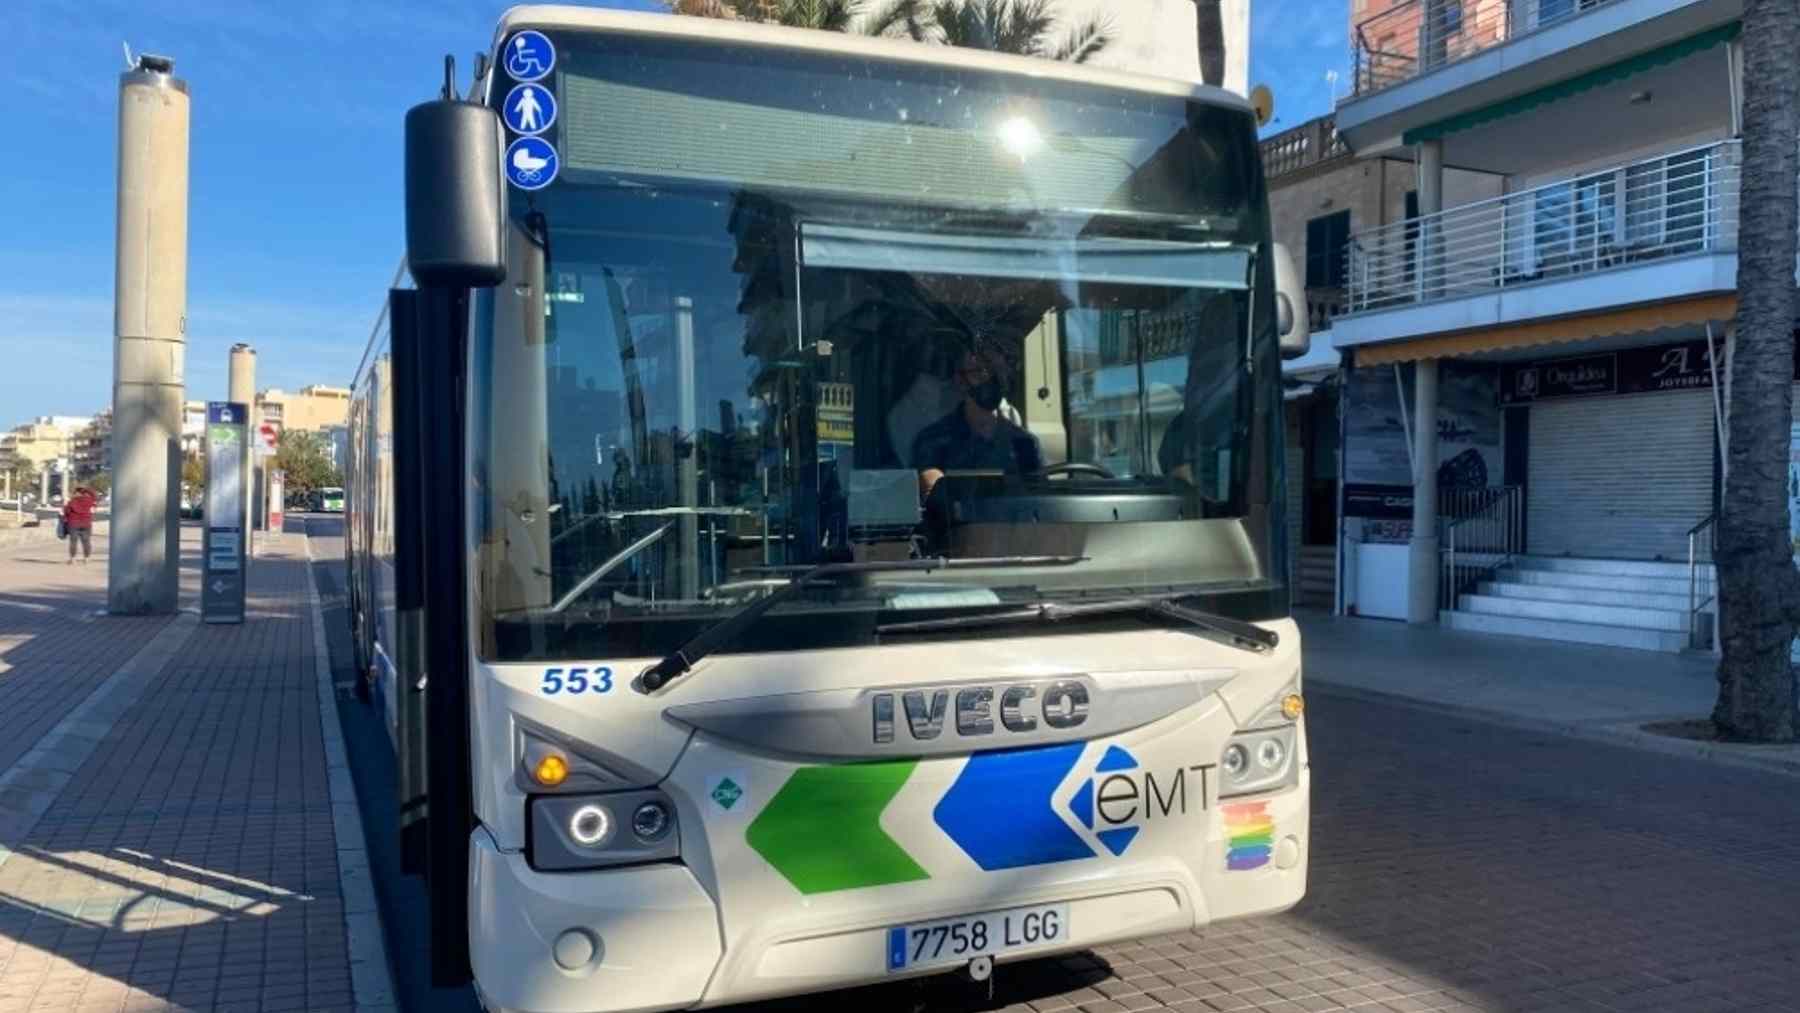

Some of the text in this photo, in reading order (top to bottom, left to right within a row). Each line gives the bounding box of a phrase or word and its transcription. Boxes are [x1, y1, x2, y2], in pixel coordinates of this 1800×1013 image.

[541, 666, 613, 695] 553
[872, 680, 1090, 744] IVECO
[911, 910, 1059, 962] 7758 LGG
